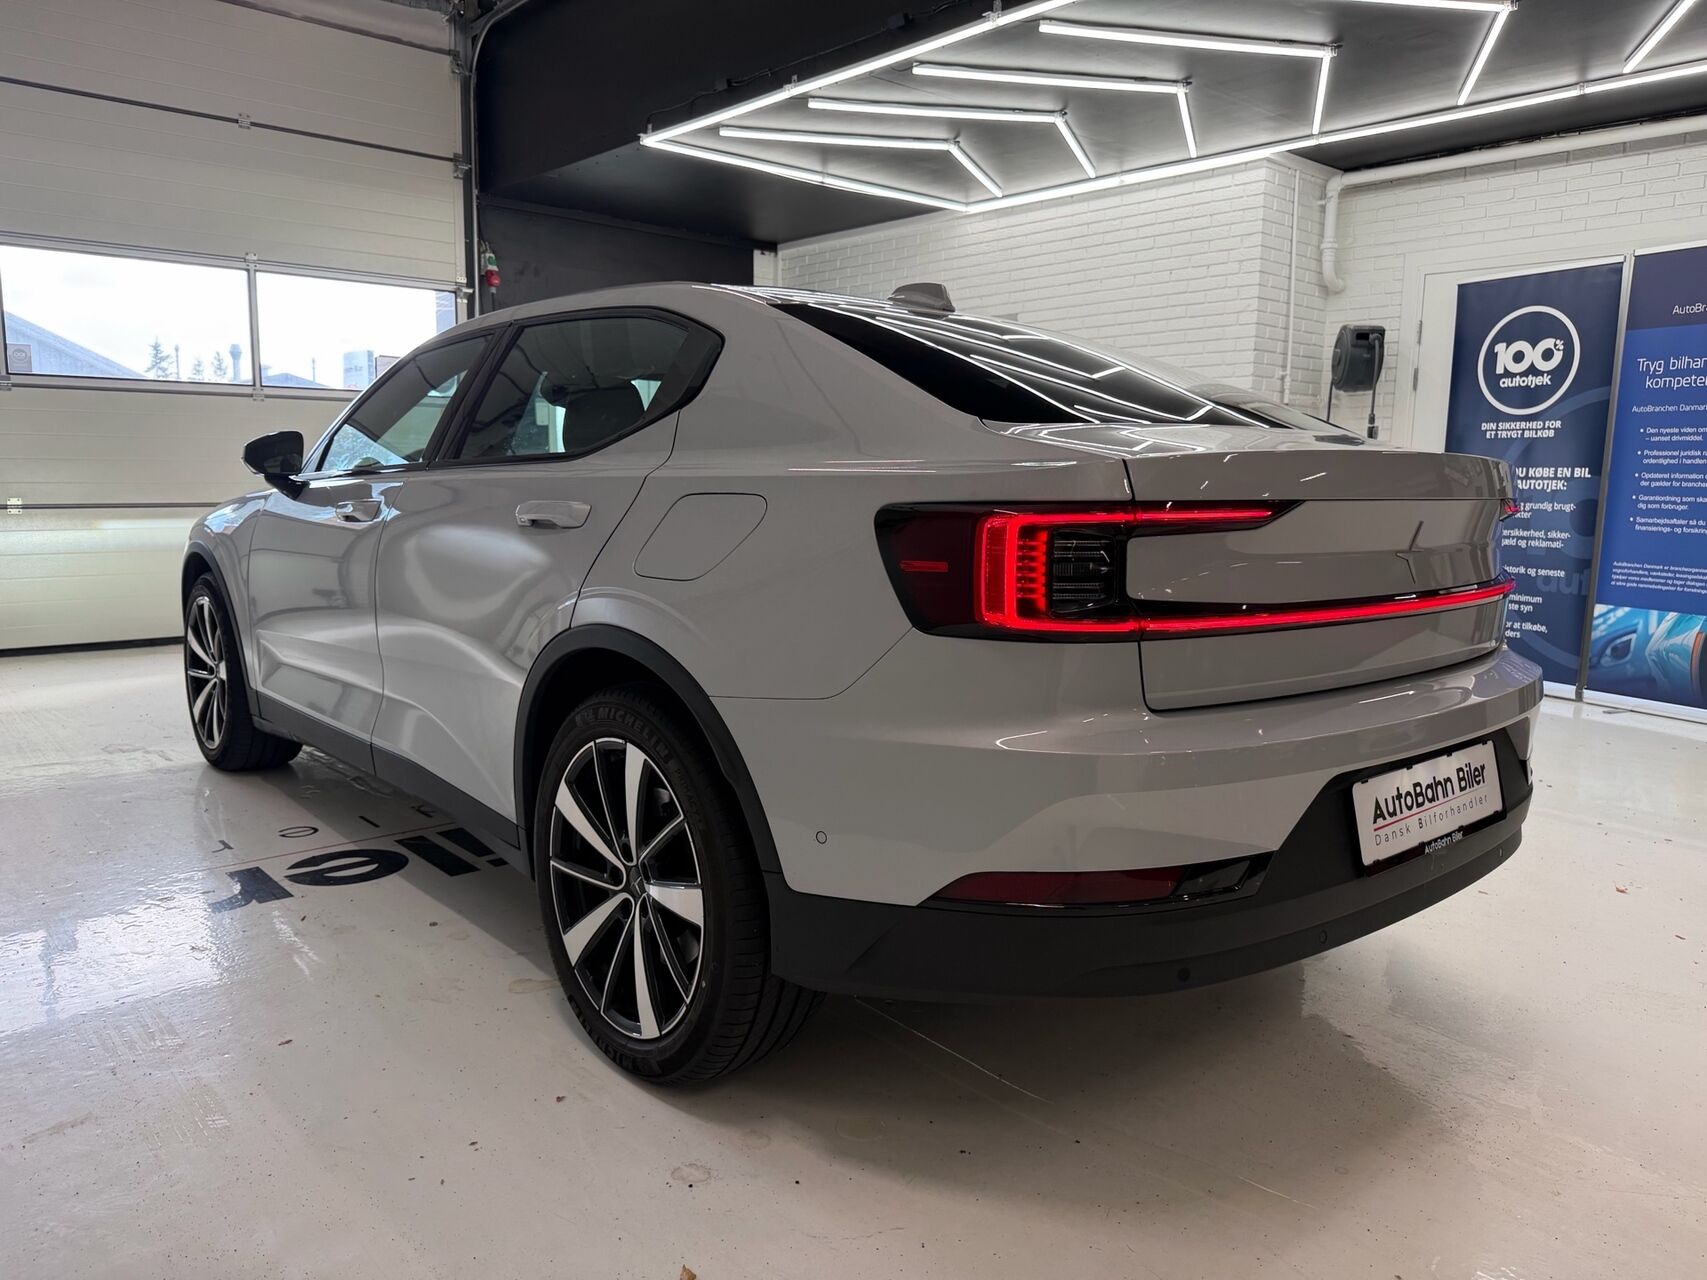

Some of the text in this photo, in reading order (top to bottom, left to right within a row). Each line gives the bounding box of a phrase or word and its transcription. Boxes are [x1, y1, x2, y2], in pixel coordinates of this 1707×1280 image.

[1637, 358, 1664, 374] Tryg
[1500, 374, 1551, 388] autotjek
[1632, 404, 1678, 412] AutoBranchen
[1498, 422, 1543, 430] SIKKERHED
[1544, 420, 1562, 428] FOR
[1498, 430, 1522, 438] TRYGT
[1524, 429, 1554, 438] BILKØB
[1516, 467, 1526, 477] U
[1528, 467, 1554, 478] KØBE
[1557, 468, 1571, 478] EN
[1525, 502, 1552, 512] grundig
[1554, 502, 1576, 512] brugt-
[1502, 528, 1546, 539] ersikkerhed,
[1518, 540, 1526, 548] og
[1527, 568, 1536, 576] og
[1538, 569, 1566, 578] seneste
[1520, 604, 1532, 613] syn
[597, 706, 671, 760] MICHELIN
[1373, 762, 1486, 824] AutoBahn Biler
[1375, 794, 1488, 846] Dansk Bilforhandler
[1424, 837, 1452, 855] AutoBahn
